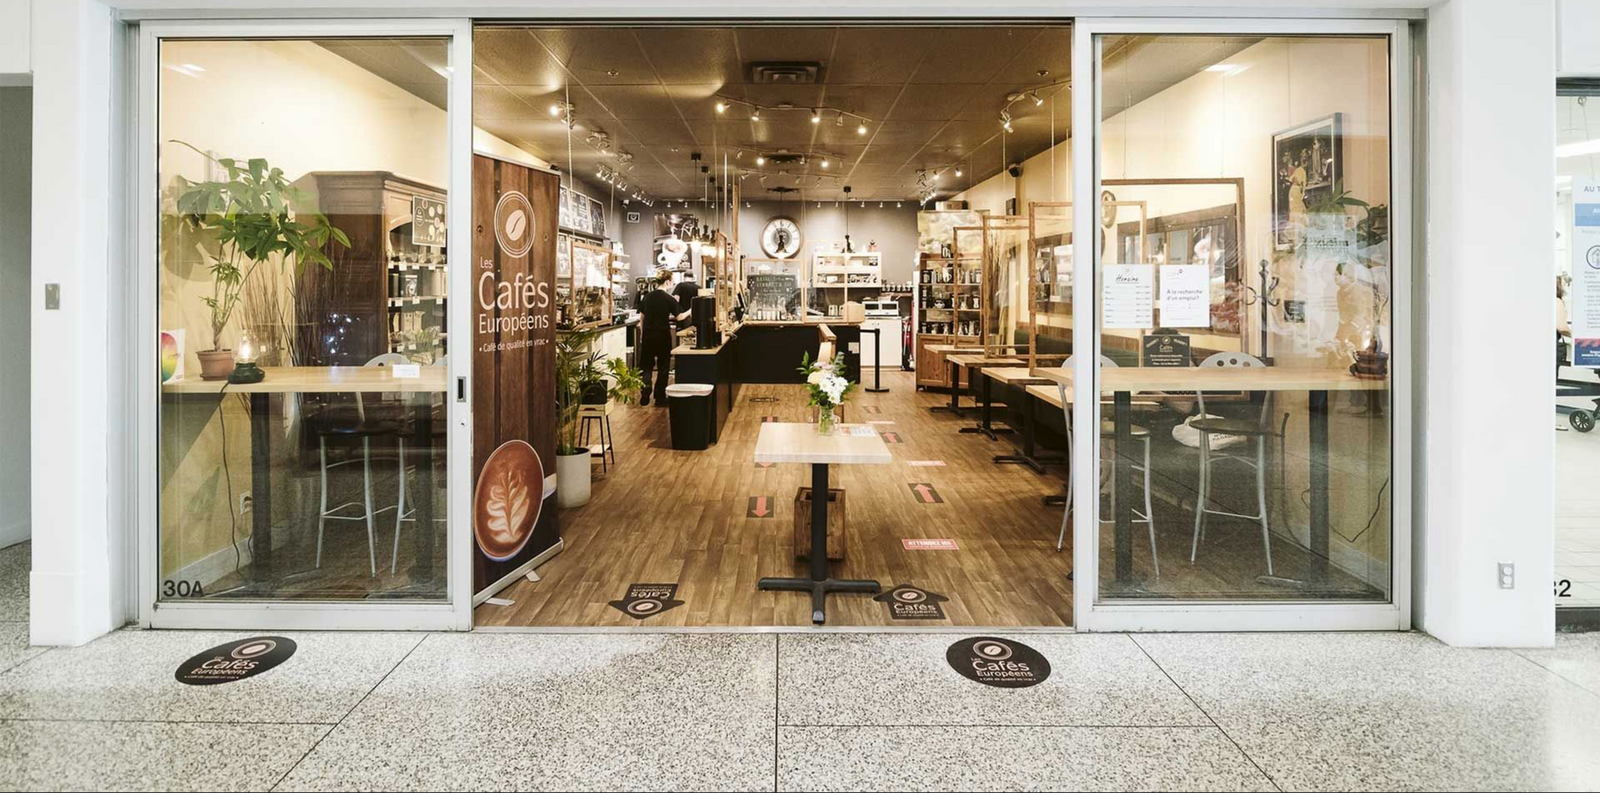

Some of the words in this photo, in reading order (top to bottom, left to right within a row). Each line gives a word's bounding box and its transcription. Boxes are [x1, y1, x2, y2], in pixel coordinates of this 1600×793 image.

[480, 256, 493, 269] Les
[478, 271, 549, 311] Cafés
[479, 312, 549, 336] Européens
[483, 342, 496, 353] Café
[497, 341, 506, 351] de
[506, 339, 525, 351] qualité
[526, 339, 533, 347] en
[534, 338, 546, 346] vrac
[163, 580, 205, 597] 30A
[201, 659, 259, 669] Cafés
[972, 661, 1030, 671] Cafés
[976, 670, 1034, 678] Européens
